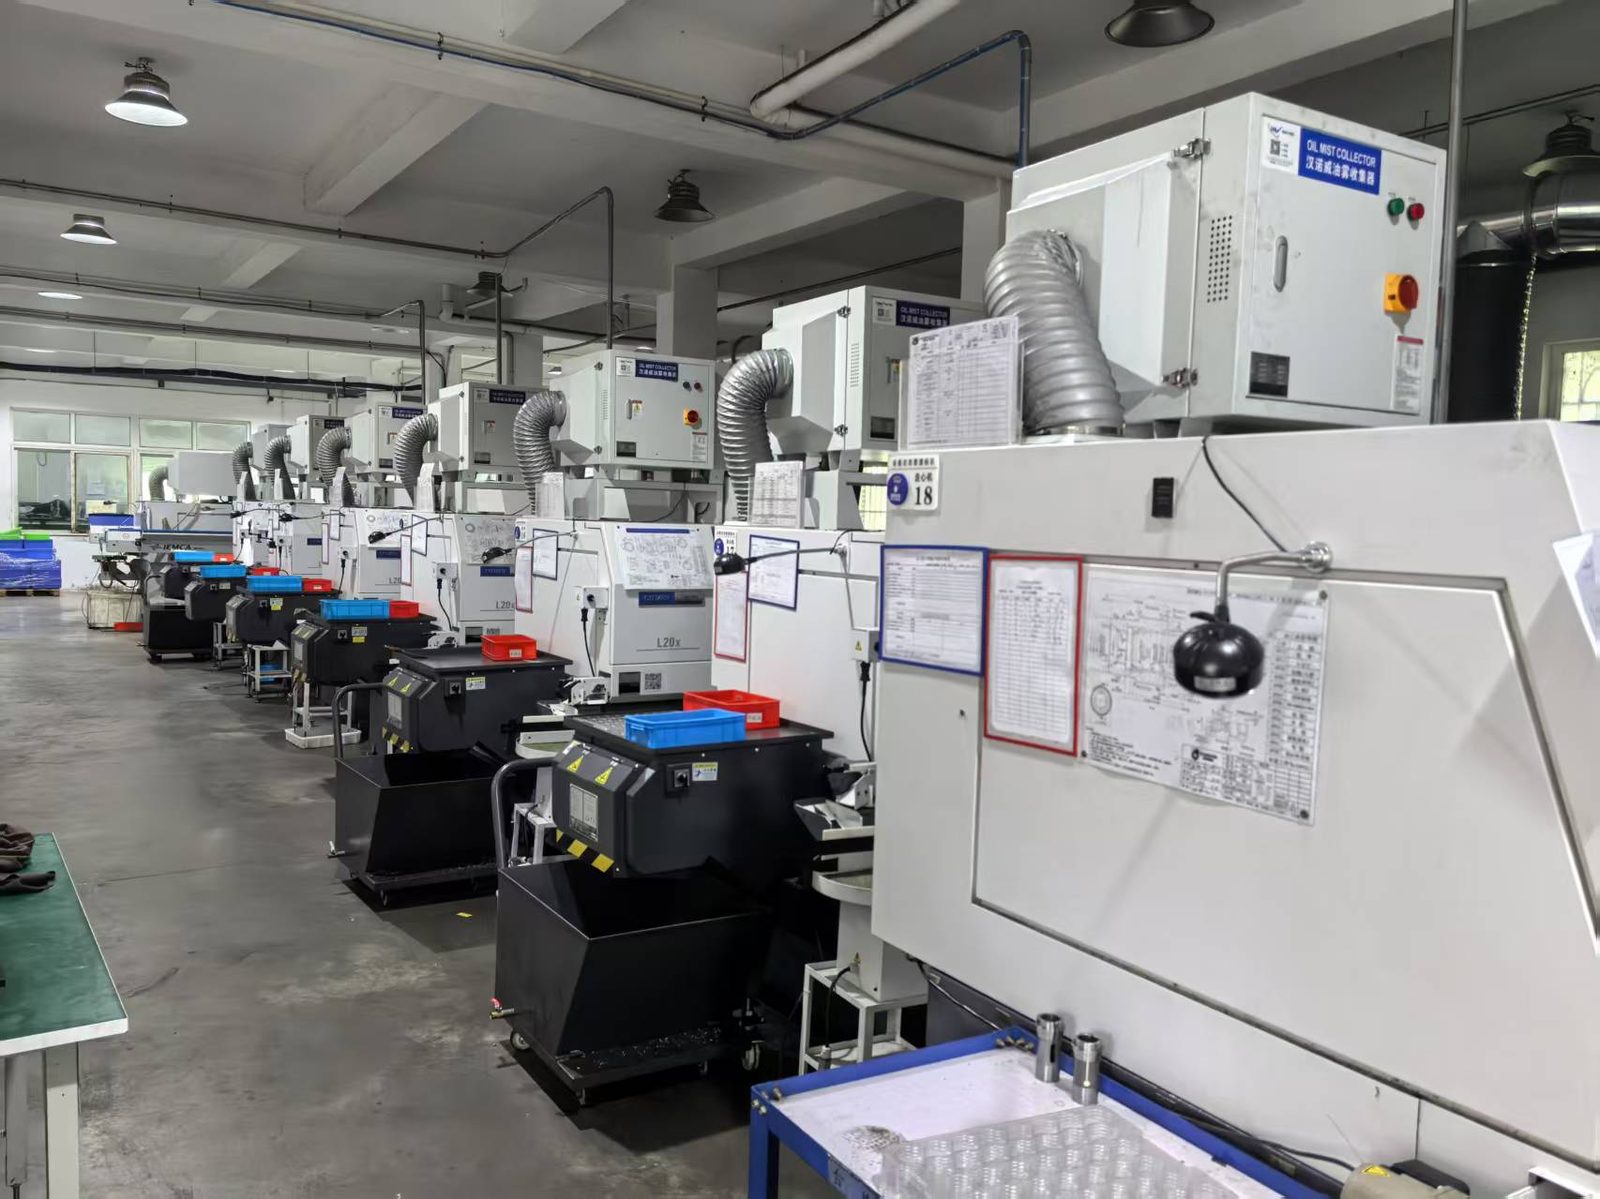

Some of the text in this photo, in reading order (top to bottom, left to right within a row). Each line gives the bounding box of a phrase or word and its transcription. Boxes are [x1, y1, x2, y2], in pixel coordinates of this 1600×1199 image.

[1307, 140, 1375, 167] OIL MIST COLLECTOR
[1306, 156, 1374, 185] 汉诺威油雾收集器
[915, 486, 933, 505] 18
[656, 637, 682, 648] L20x
